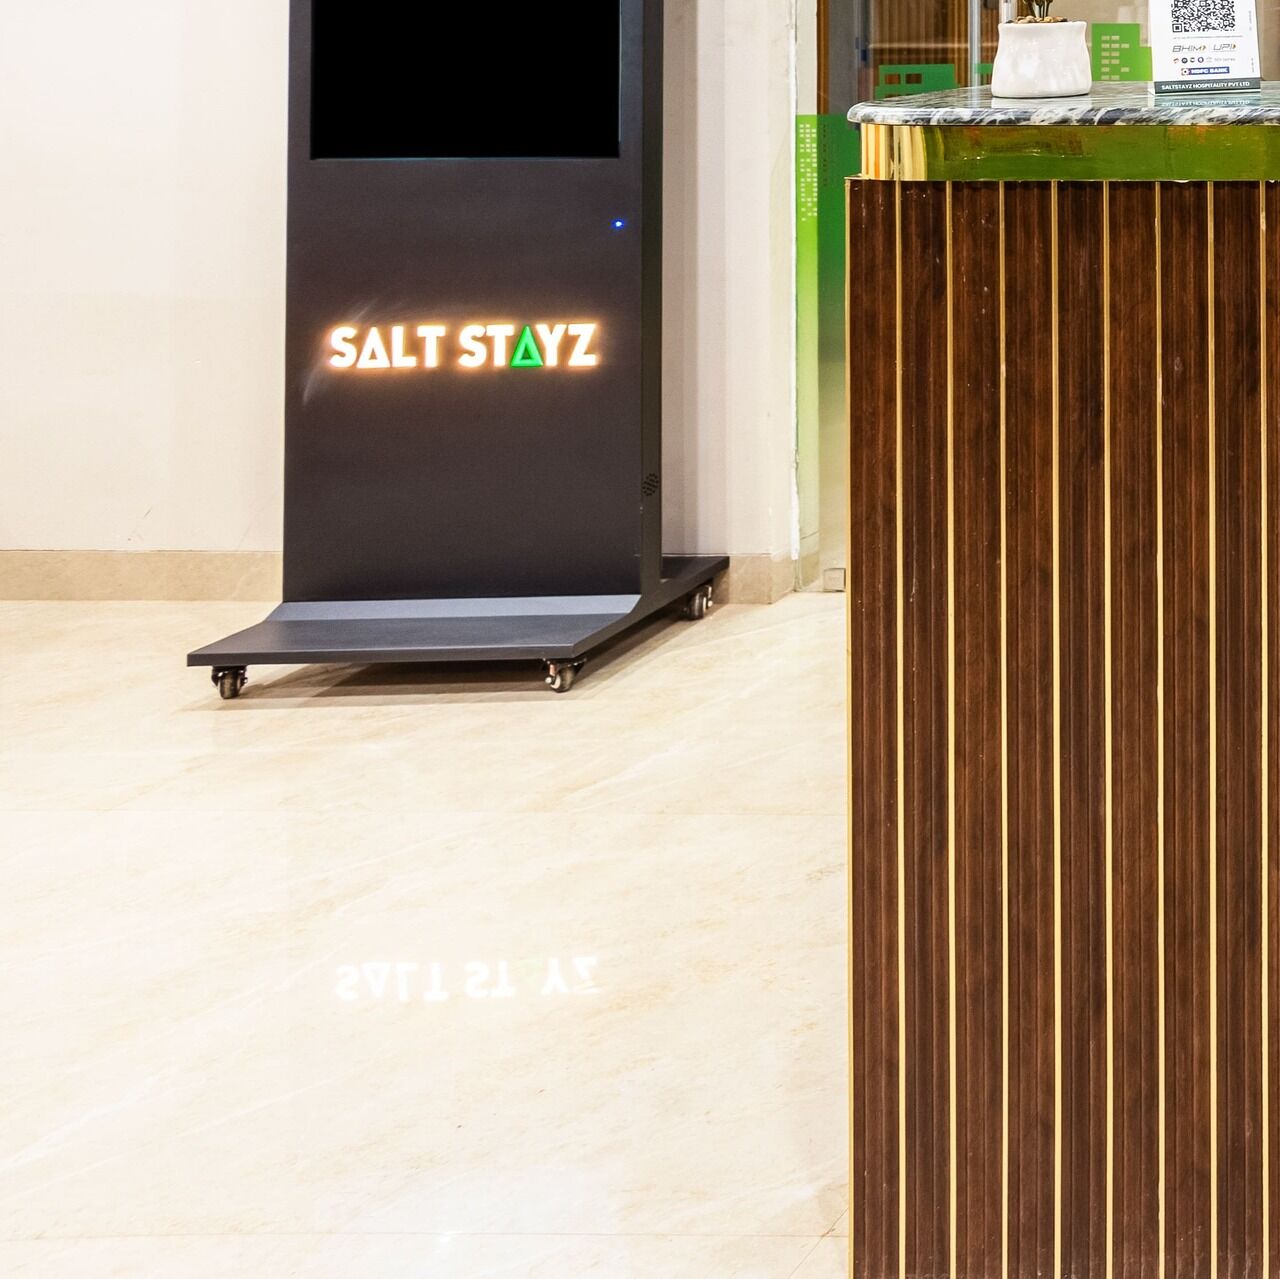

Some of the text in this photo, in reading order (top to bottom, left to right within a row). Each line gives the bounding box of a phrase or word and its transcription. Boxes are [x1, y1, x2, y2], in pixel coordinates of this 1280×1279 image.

[1172, 45, 1202, 53] BHIM
[330, 323, 597, 369] SALT STAYZ
